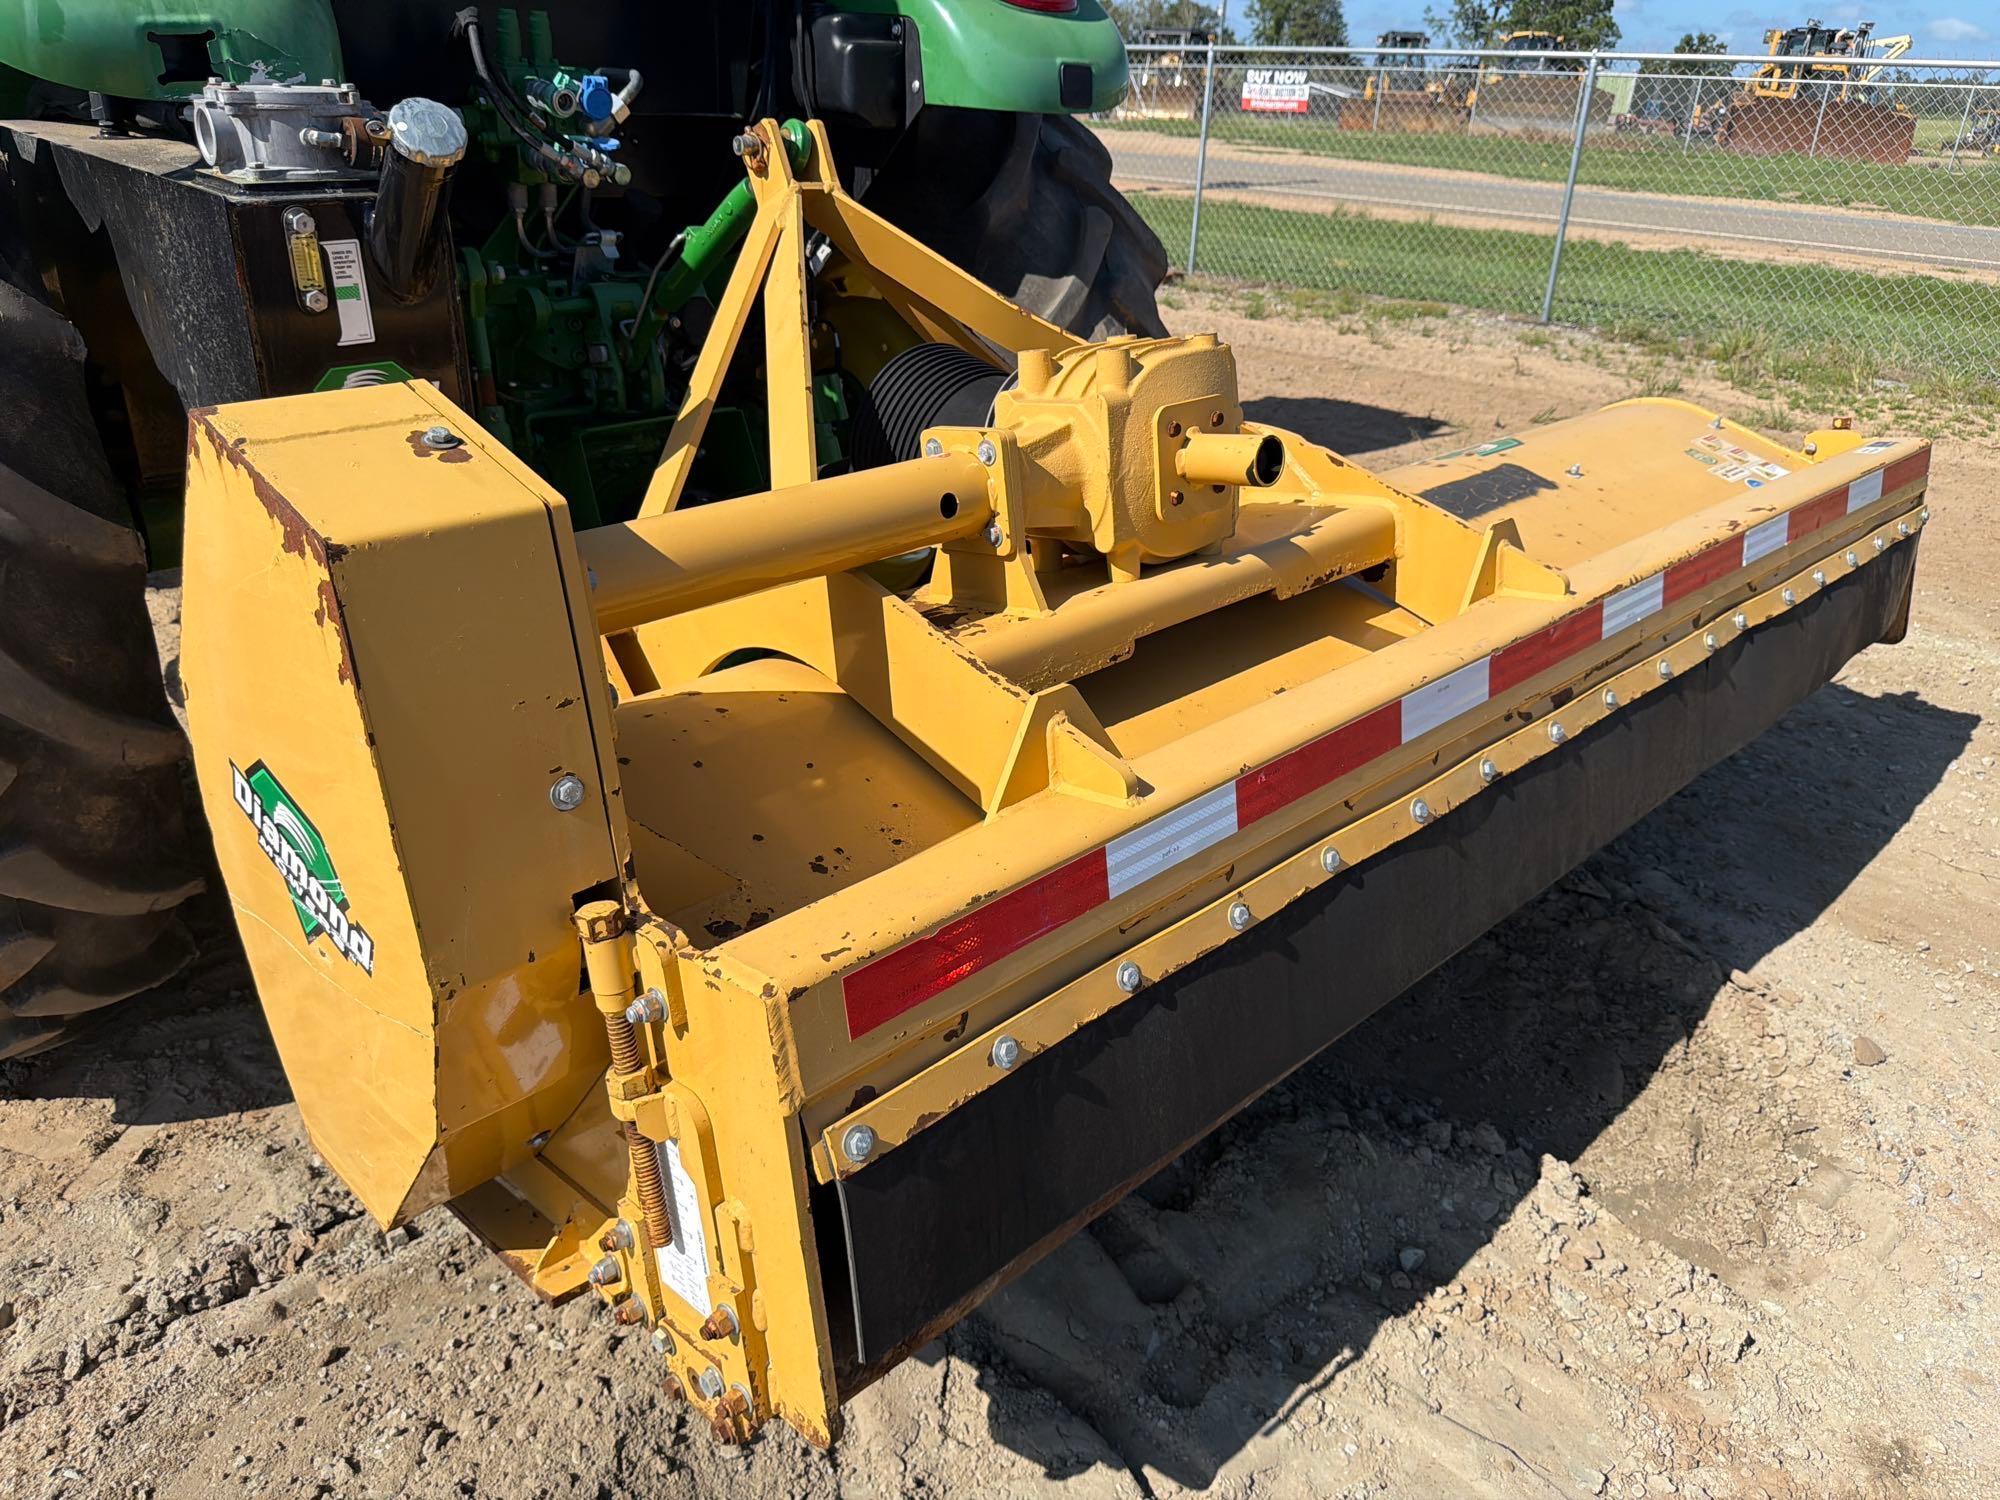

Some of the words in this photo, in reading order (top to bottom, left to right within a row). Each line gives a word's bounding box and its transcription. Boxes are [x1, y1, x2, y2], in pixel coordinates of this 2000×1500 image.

[1247, 69, 1273, 84] BUY
[1274, 70, 1308, 84] NOW
[232, 764, 372, 972] Diamond
